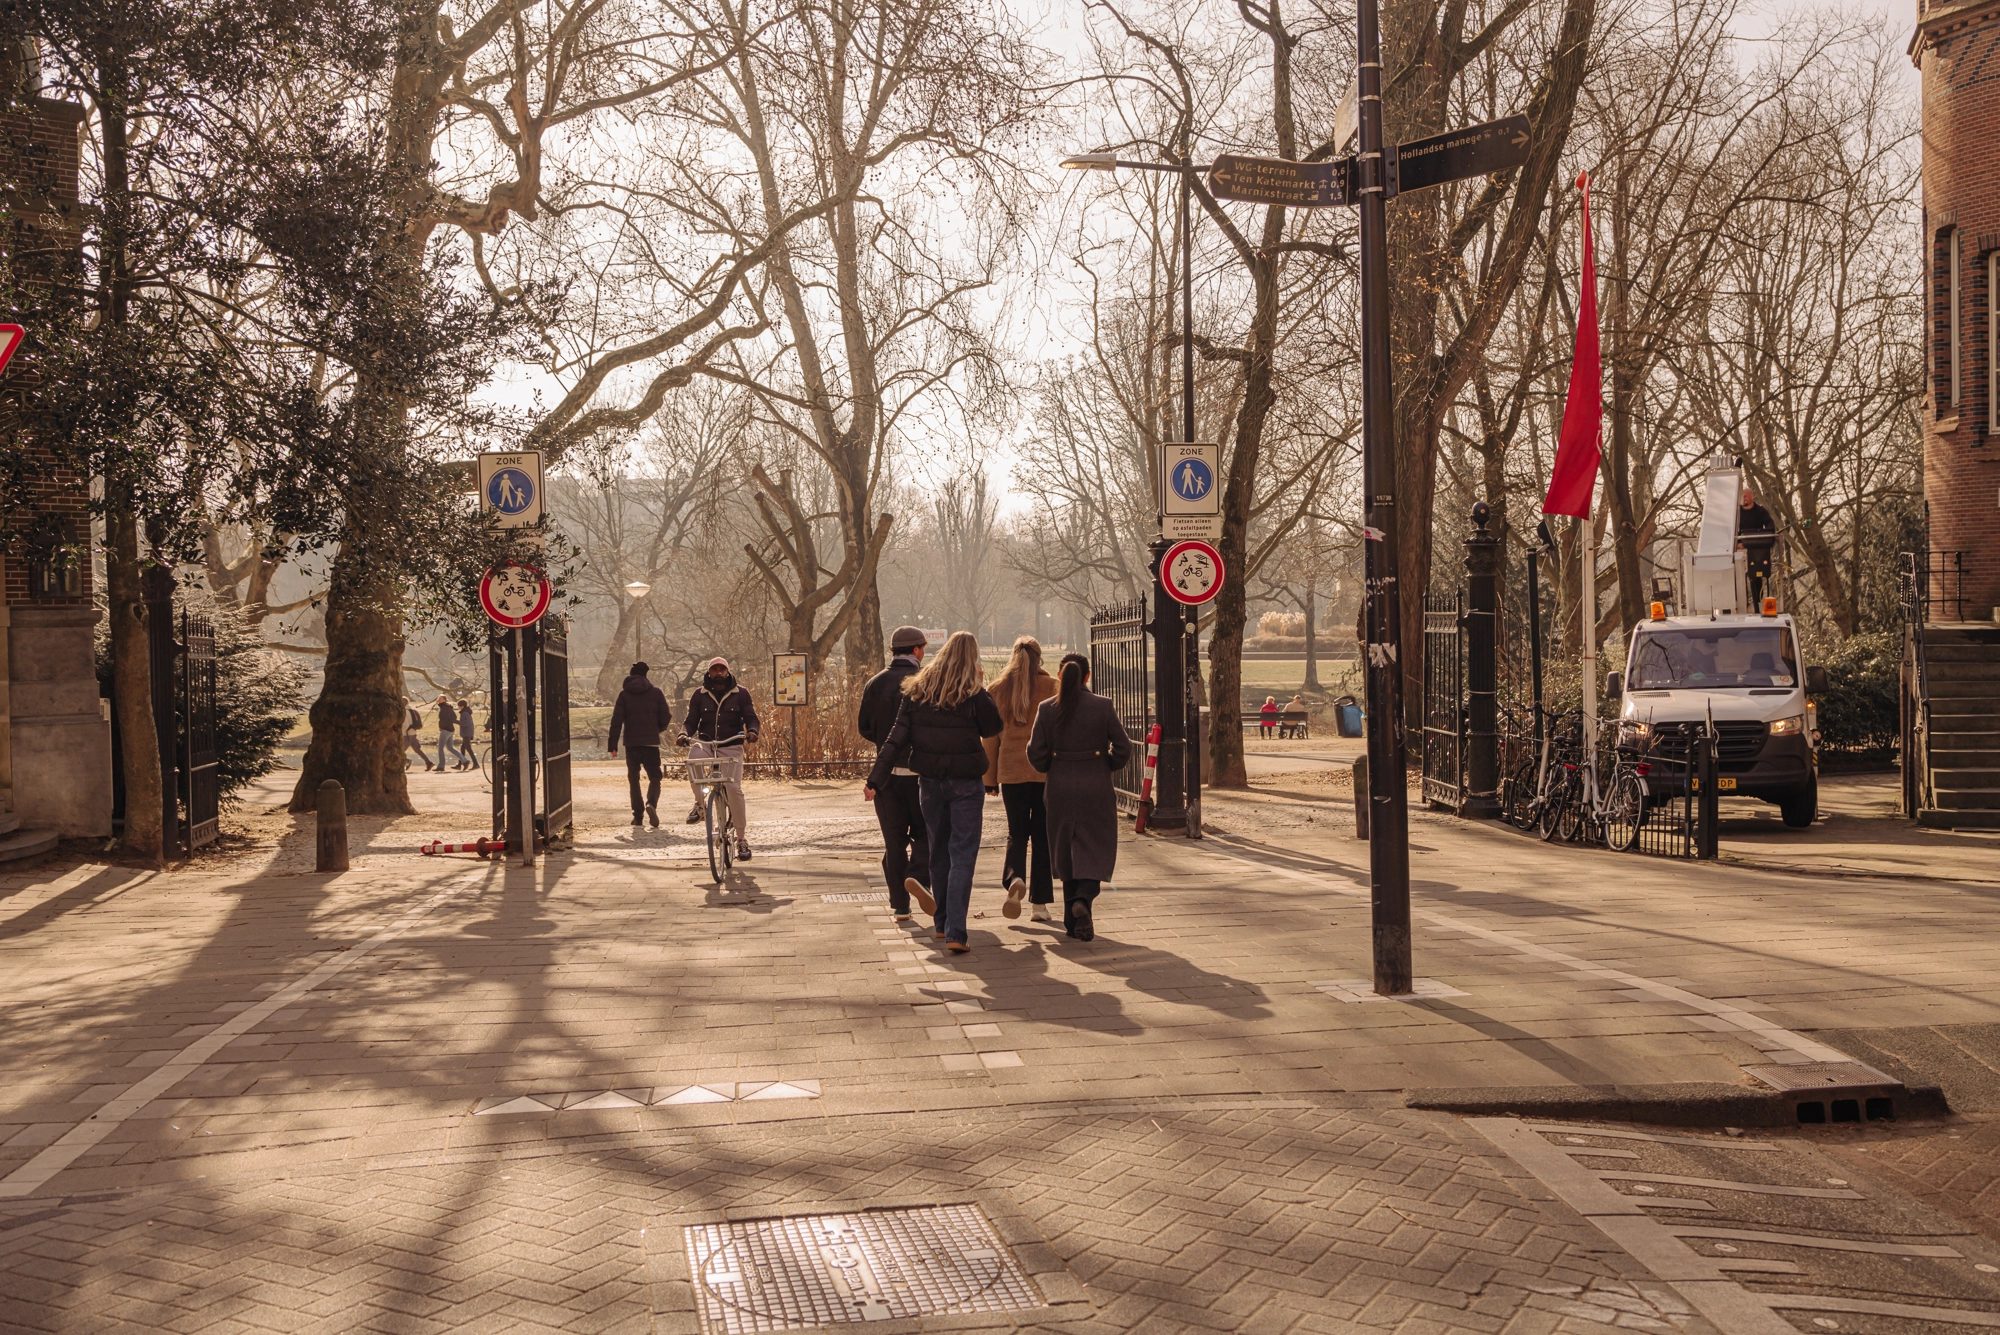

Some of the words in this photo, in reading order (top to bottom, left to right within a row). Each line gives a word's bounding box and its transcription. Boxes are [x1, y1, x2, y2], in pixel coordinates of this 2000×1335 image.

[1400, 144, 1444, 160] Hollandse
[1446, 134, 1482, 149] manege
[1498, 126, 1510, 136] 0,1
[1234, 161, 1297, 177] WG-terrein
[1331, 167, 1346, 177] 0,6
[1233, 173, 1253, 184] Ten
[1256, 175, 1316, 189] Katemarkt
[1330, 179, 1345, 189] 0,9
[1231, 184, 1305, 200] Marnixstraat
[1329, 191, 1343, 201] 1,5
[496, 456, 523, 466] ZONE
